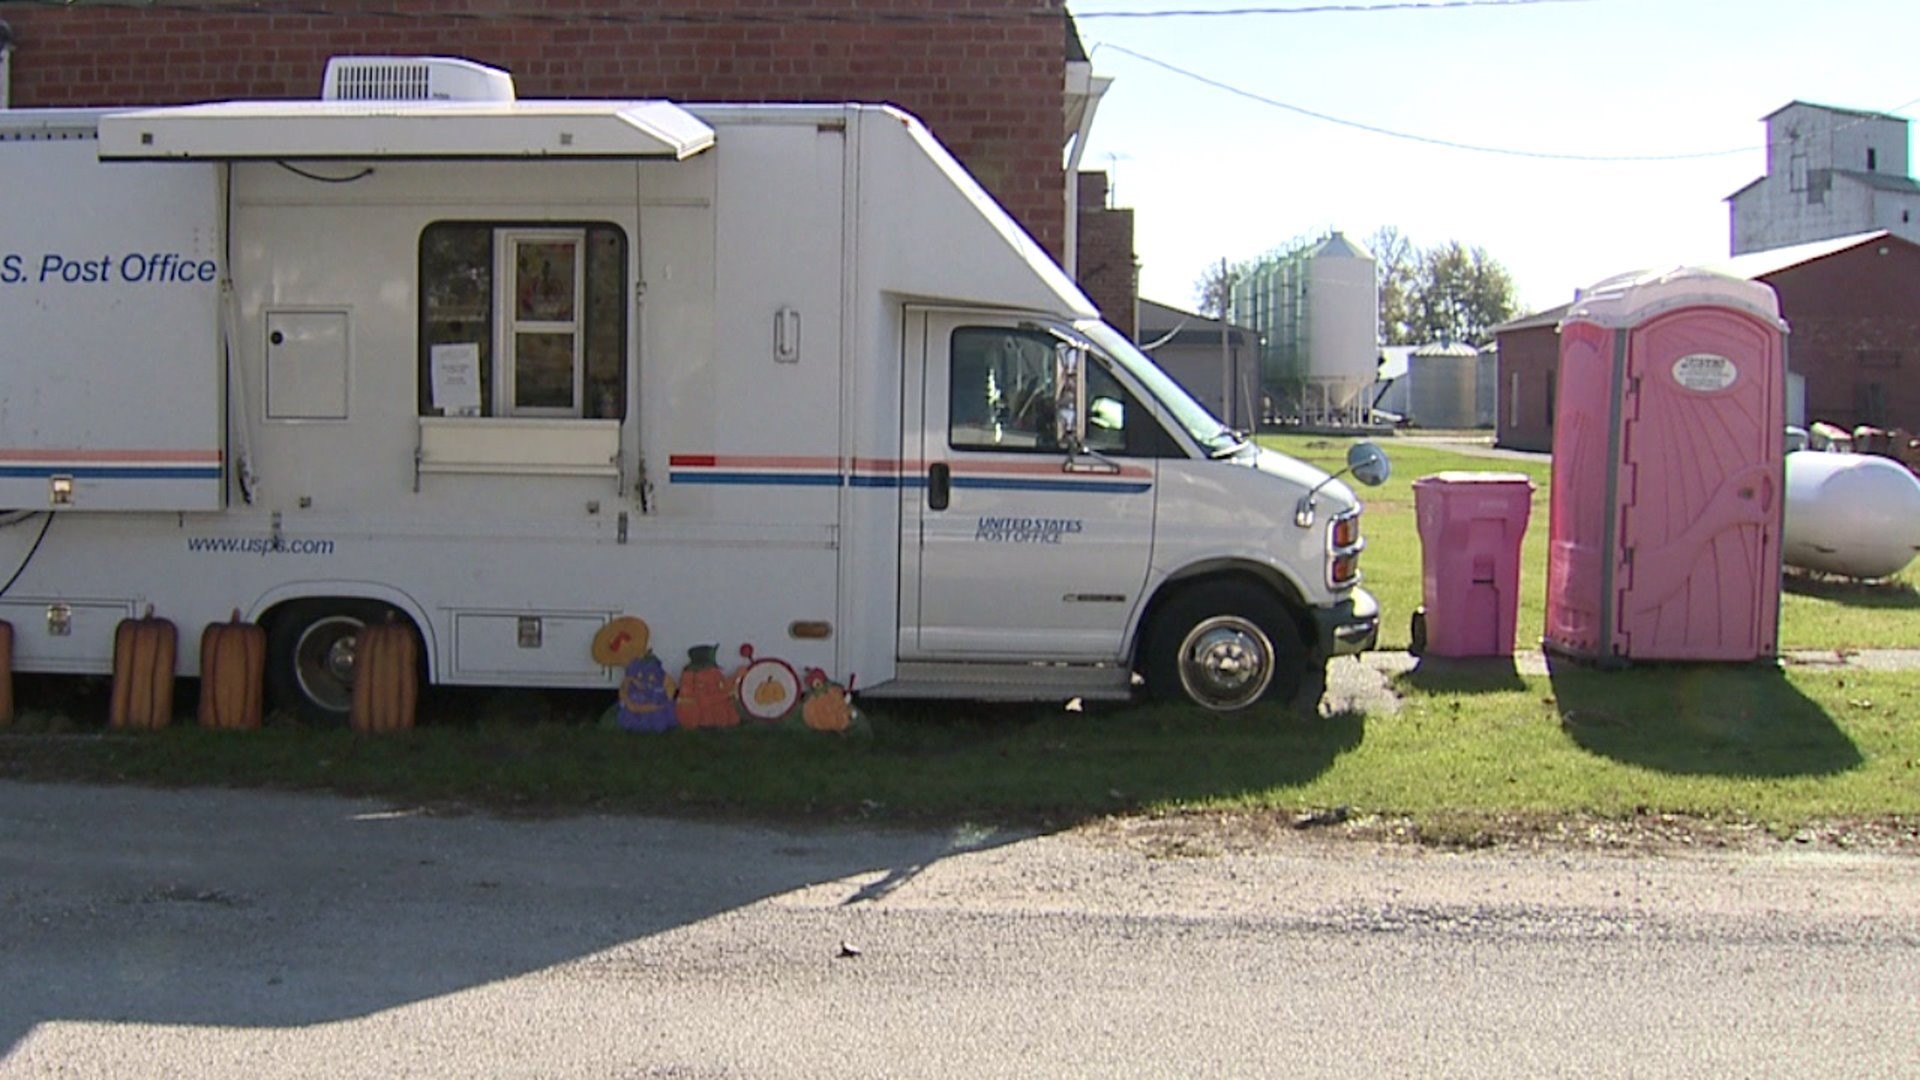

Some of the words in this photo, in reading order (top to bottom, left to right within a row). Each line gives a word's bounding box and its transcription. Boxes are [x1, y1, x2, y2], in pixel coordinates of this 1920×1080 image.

[1, 254, 28, 283] S.
[39, 254, 112, 283] Post
[120, 253, 217, 283] Office
[978, 517, 1031, 530] UNITED
[1032, 518, 1082, 533] STATES
[975, 529, 1012, 543] POST
[1013, 530, 1061, 545] OFFICE
[187, 536, 335, 557] www.usps.com
